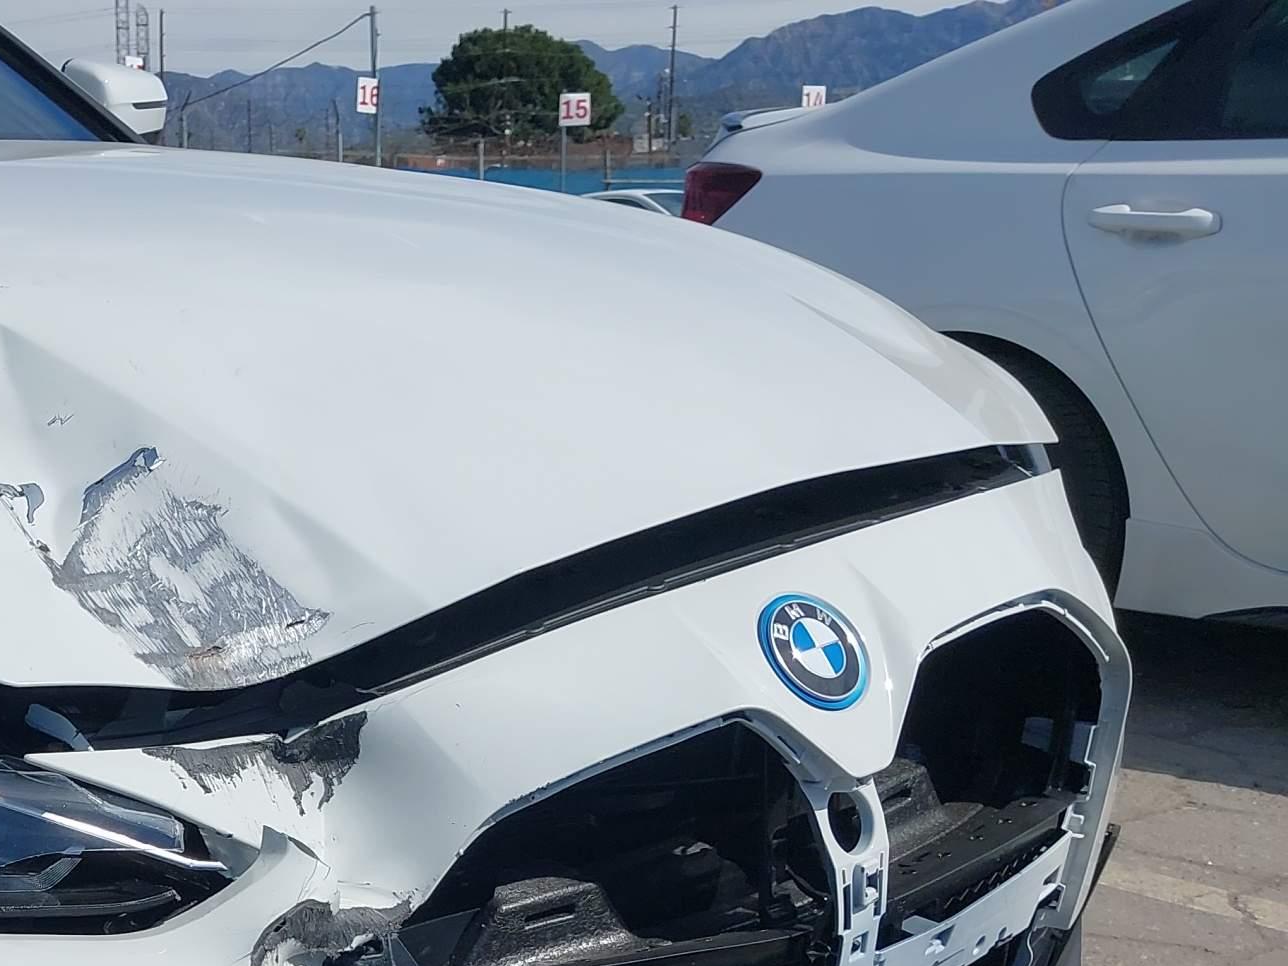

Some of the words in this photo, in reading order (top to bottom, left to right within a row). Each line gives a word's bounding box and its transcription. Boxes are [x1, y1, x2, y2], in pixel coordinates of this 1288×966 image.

[359, 85, 379, 107] 16
[562, 99, 588, 119] 15
[773, 603, 833, 641] BMW
